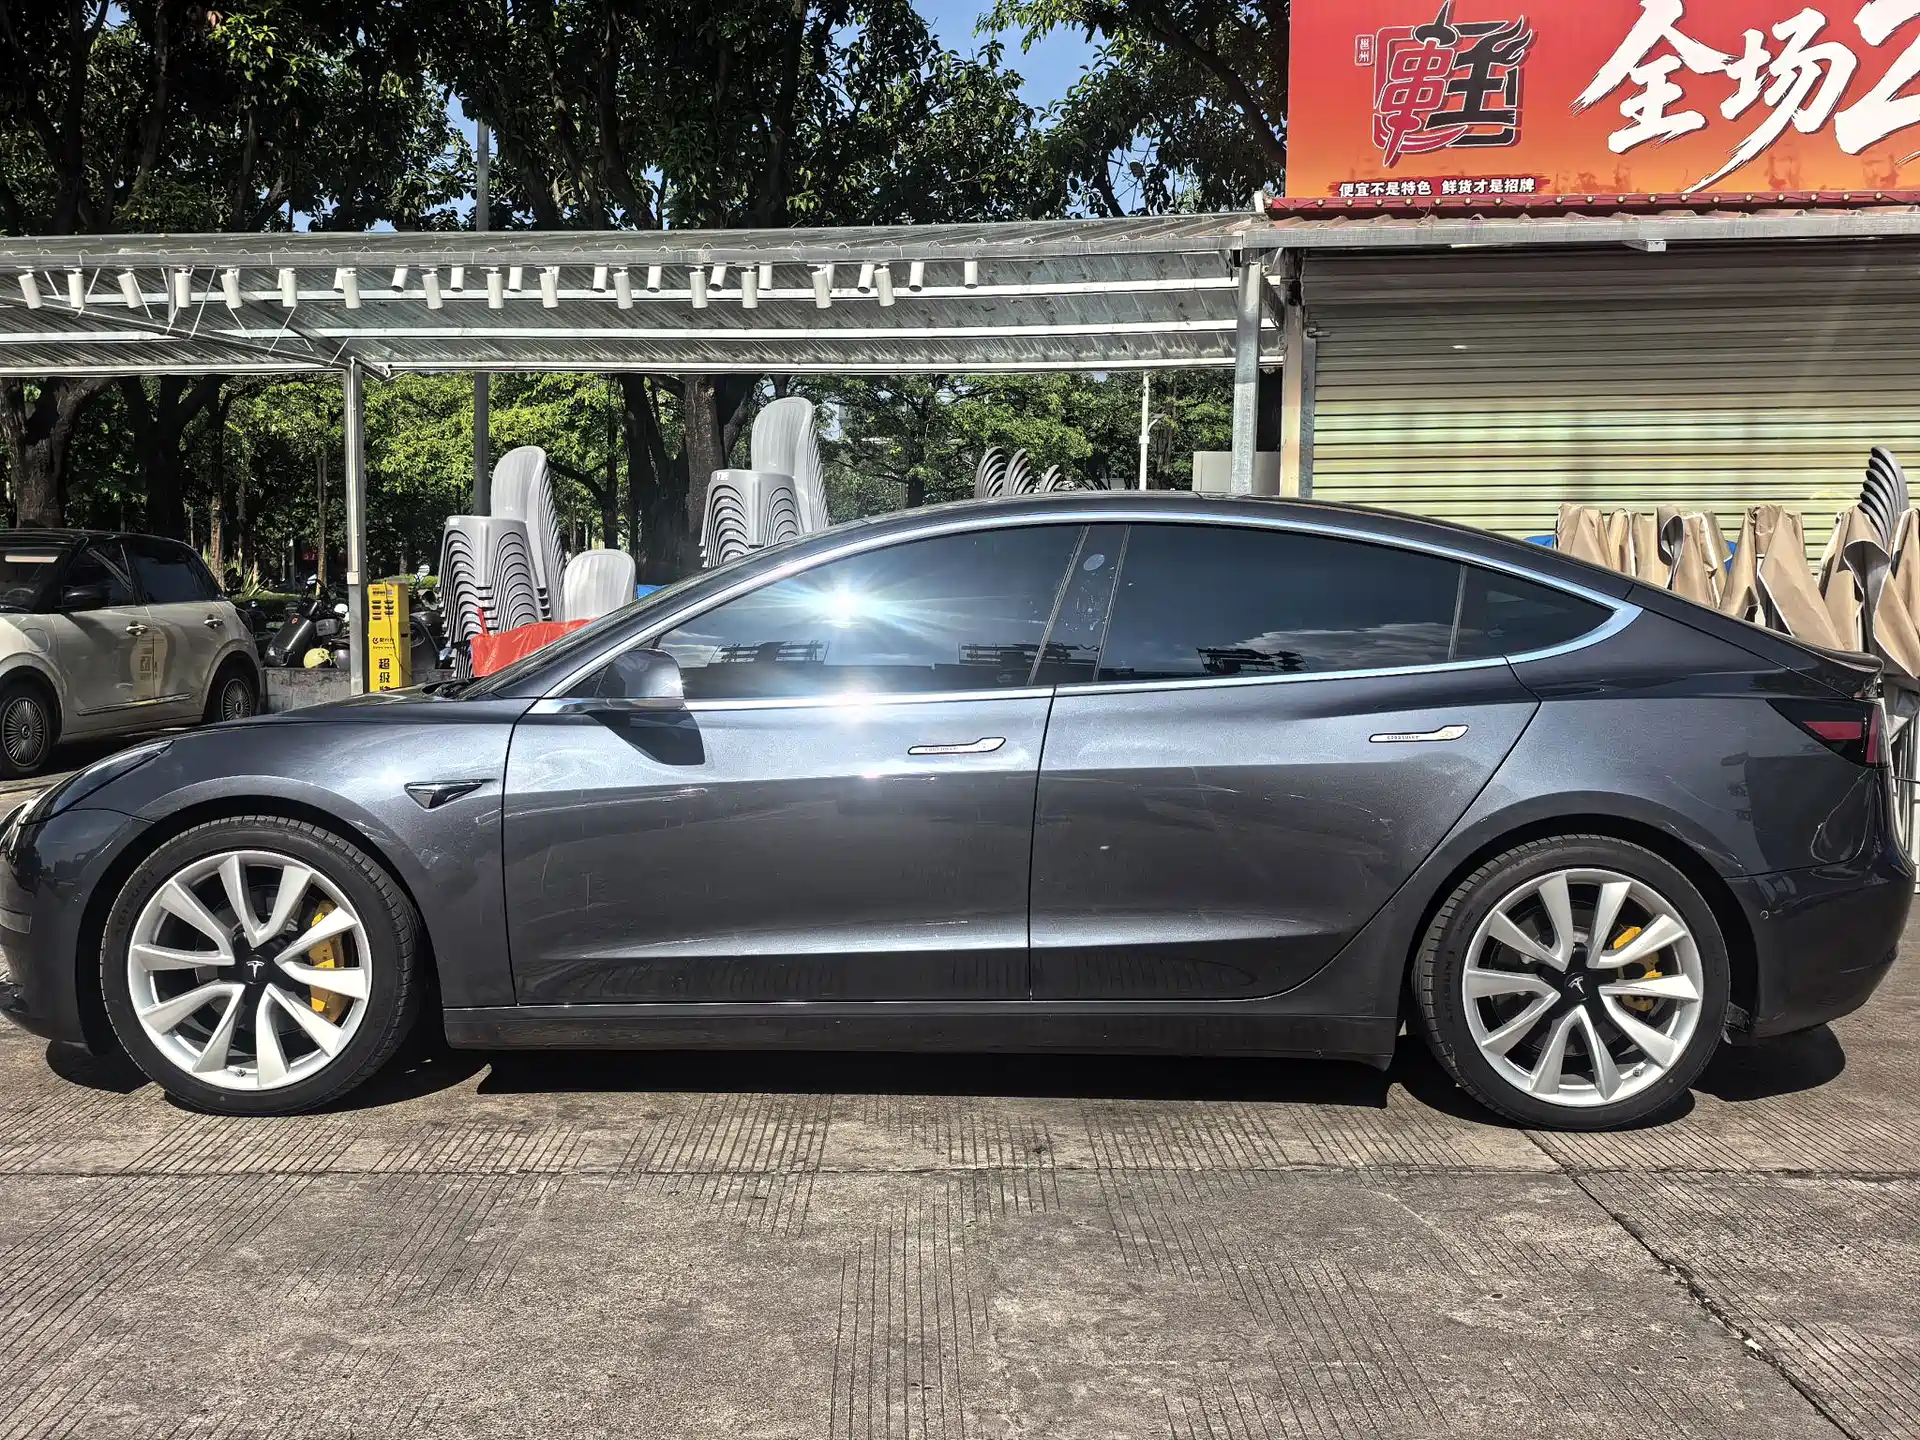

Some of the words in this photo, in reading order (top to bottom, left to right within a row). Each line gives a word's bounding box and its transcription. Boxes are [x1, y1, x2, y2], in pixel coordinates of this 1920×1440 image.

[1338, 181, 1432, 198] 便宜不是特色
[1441, 177, 1536, 195] 鲜货才是招牌
